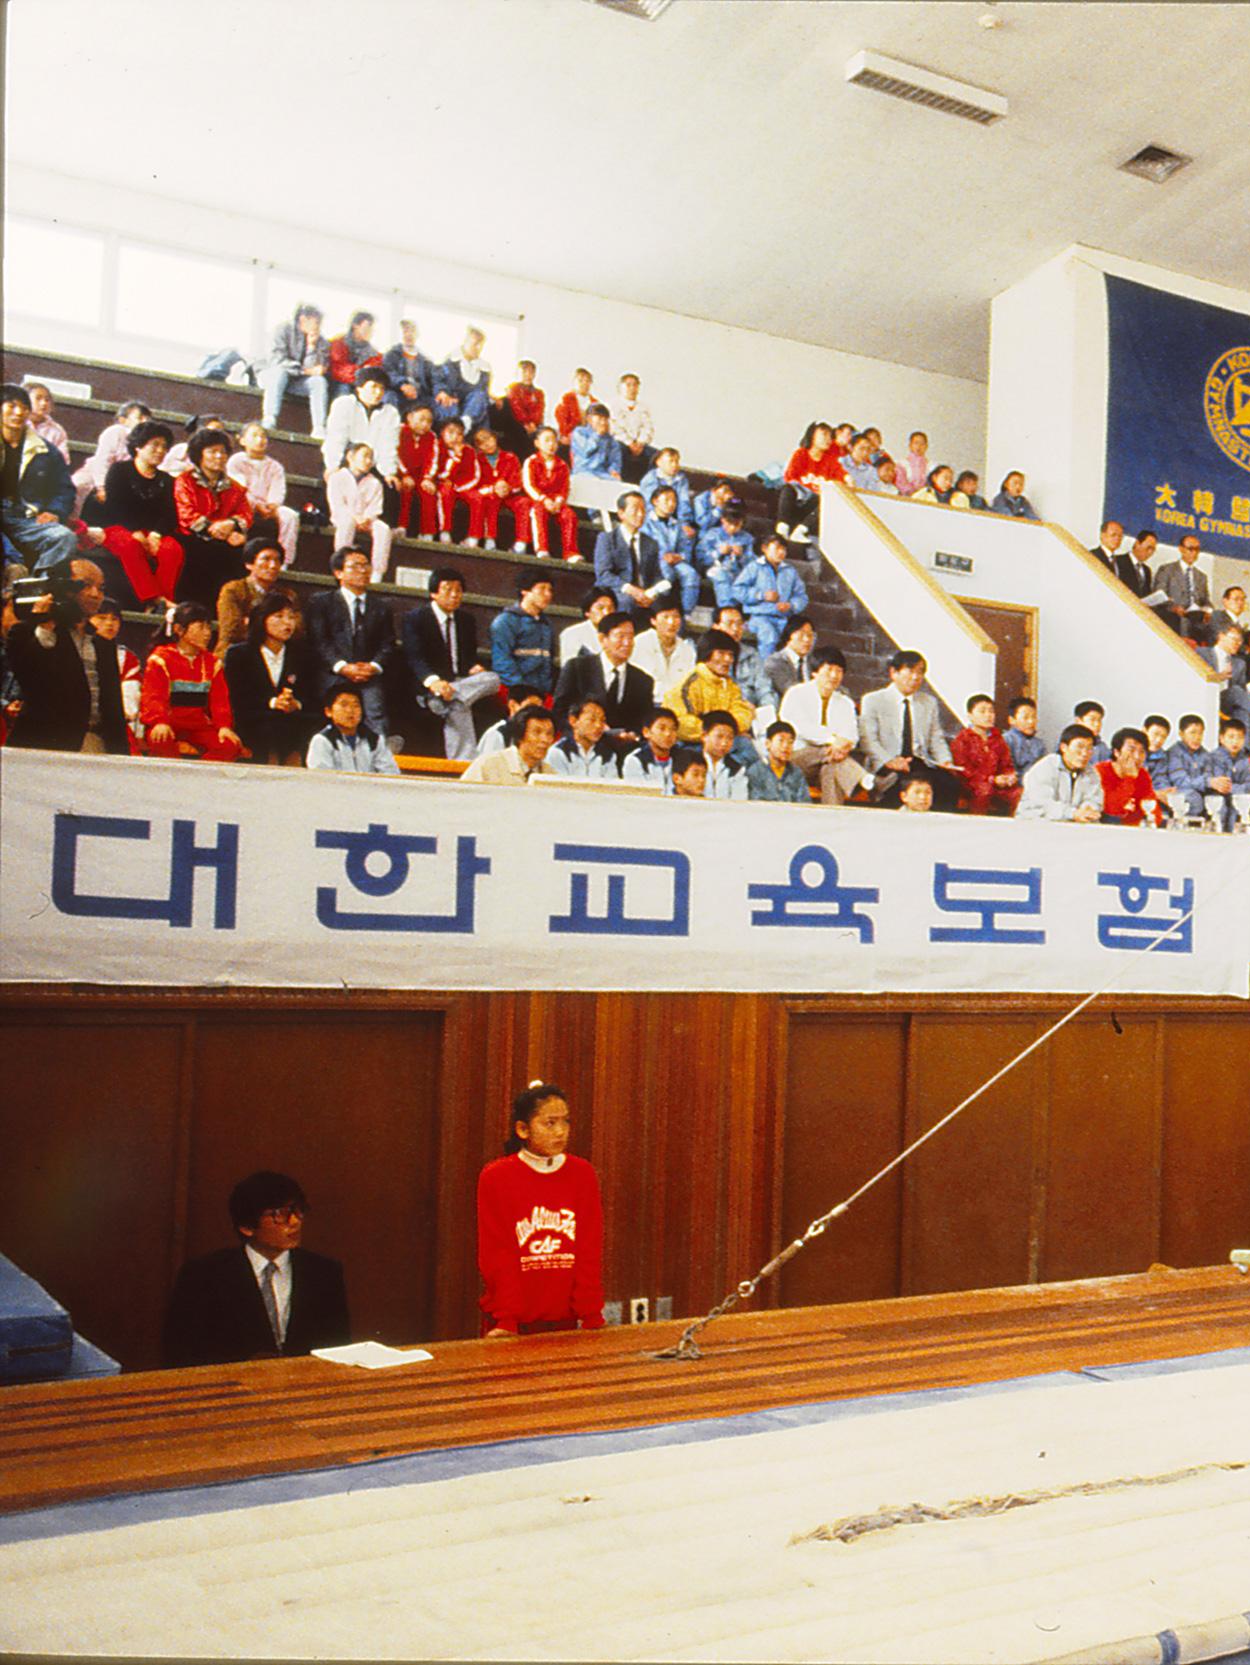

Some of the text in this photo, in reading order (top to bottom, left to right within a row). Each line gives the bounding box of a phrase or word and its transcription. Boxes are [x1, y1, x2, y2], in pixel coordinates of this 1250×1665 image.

[1155, 507, 1196, 529] KOREA
[51, 812, 1195, 954] 대한교육보험
[529, 1235, 561, 1254] CAF
